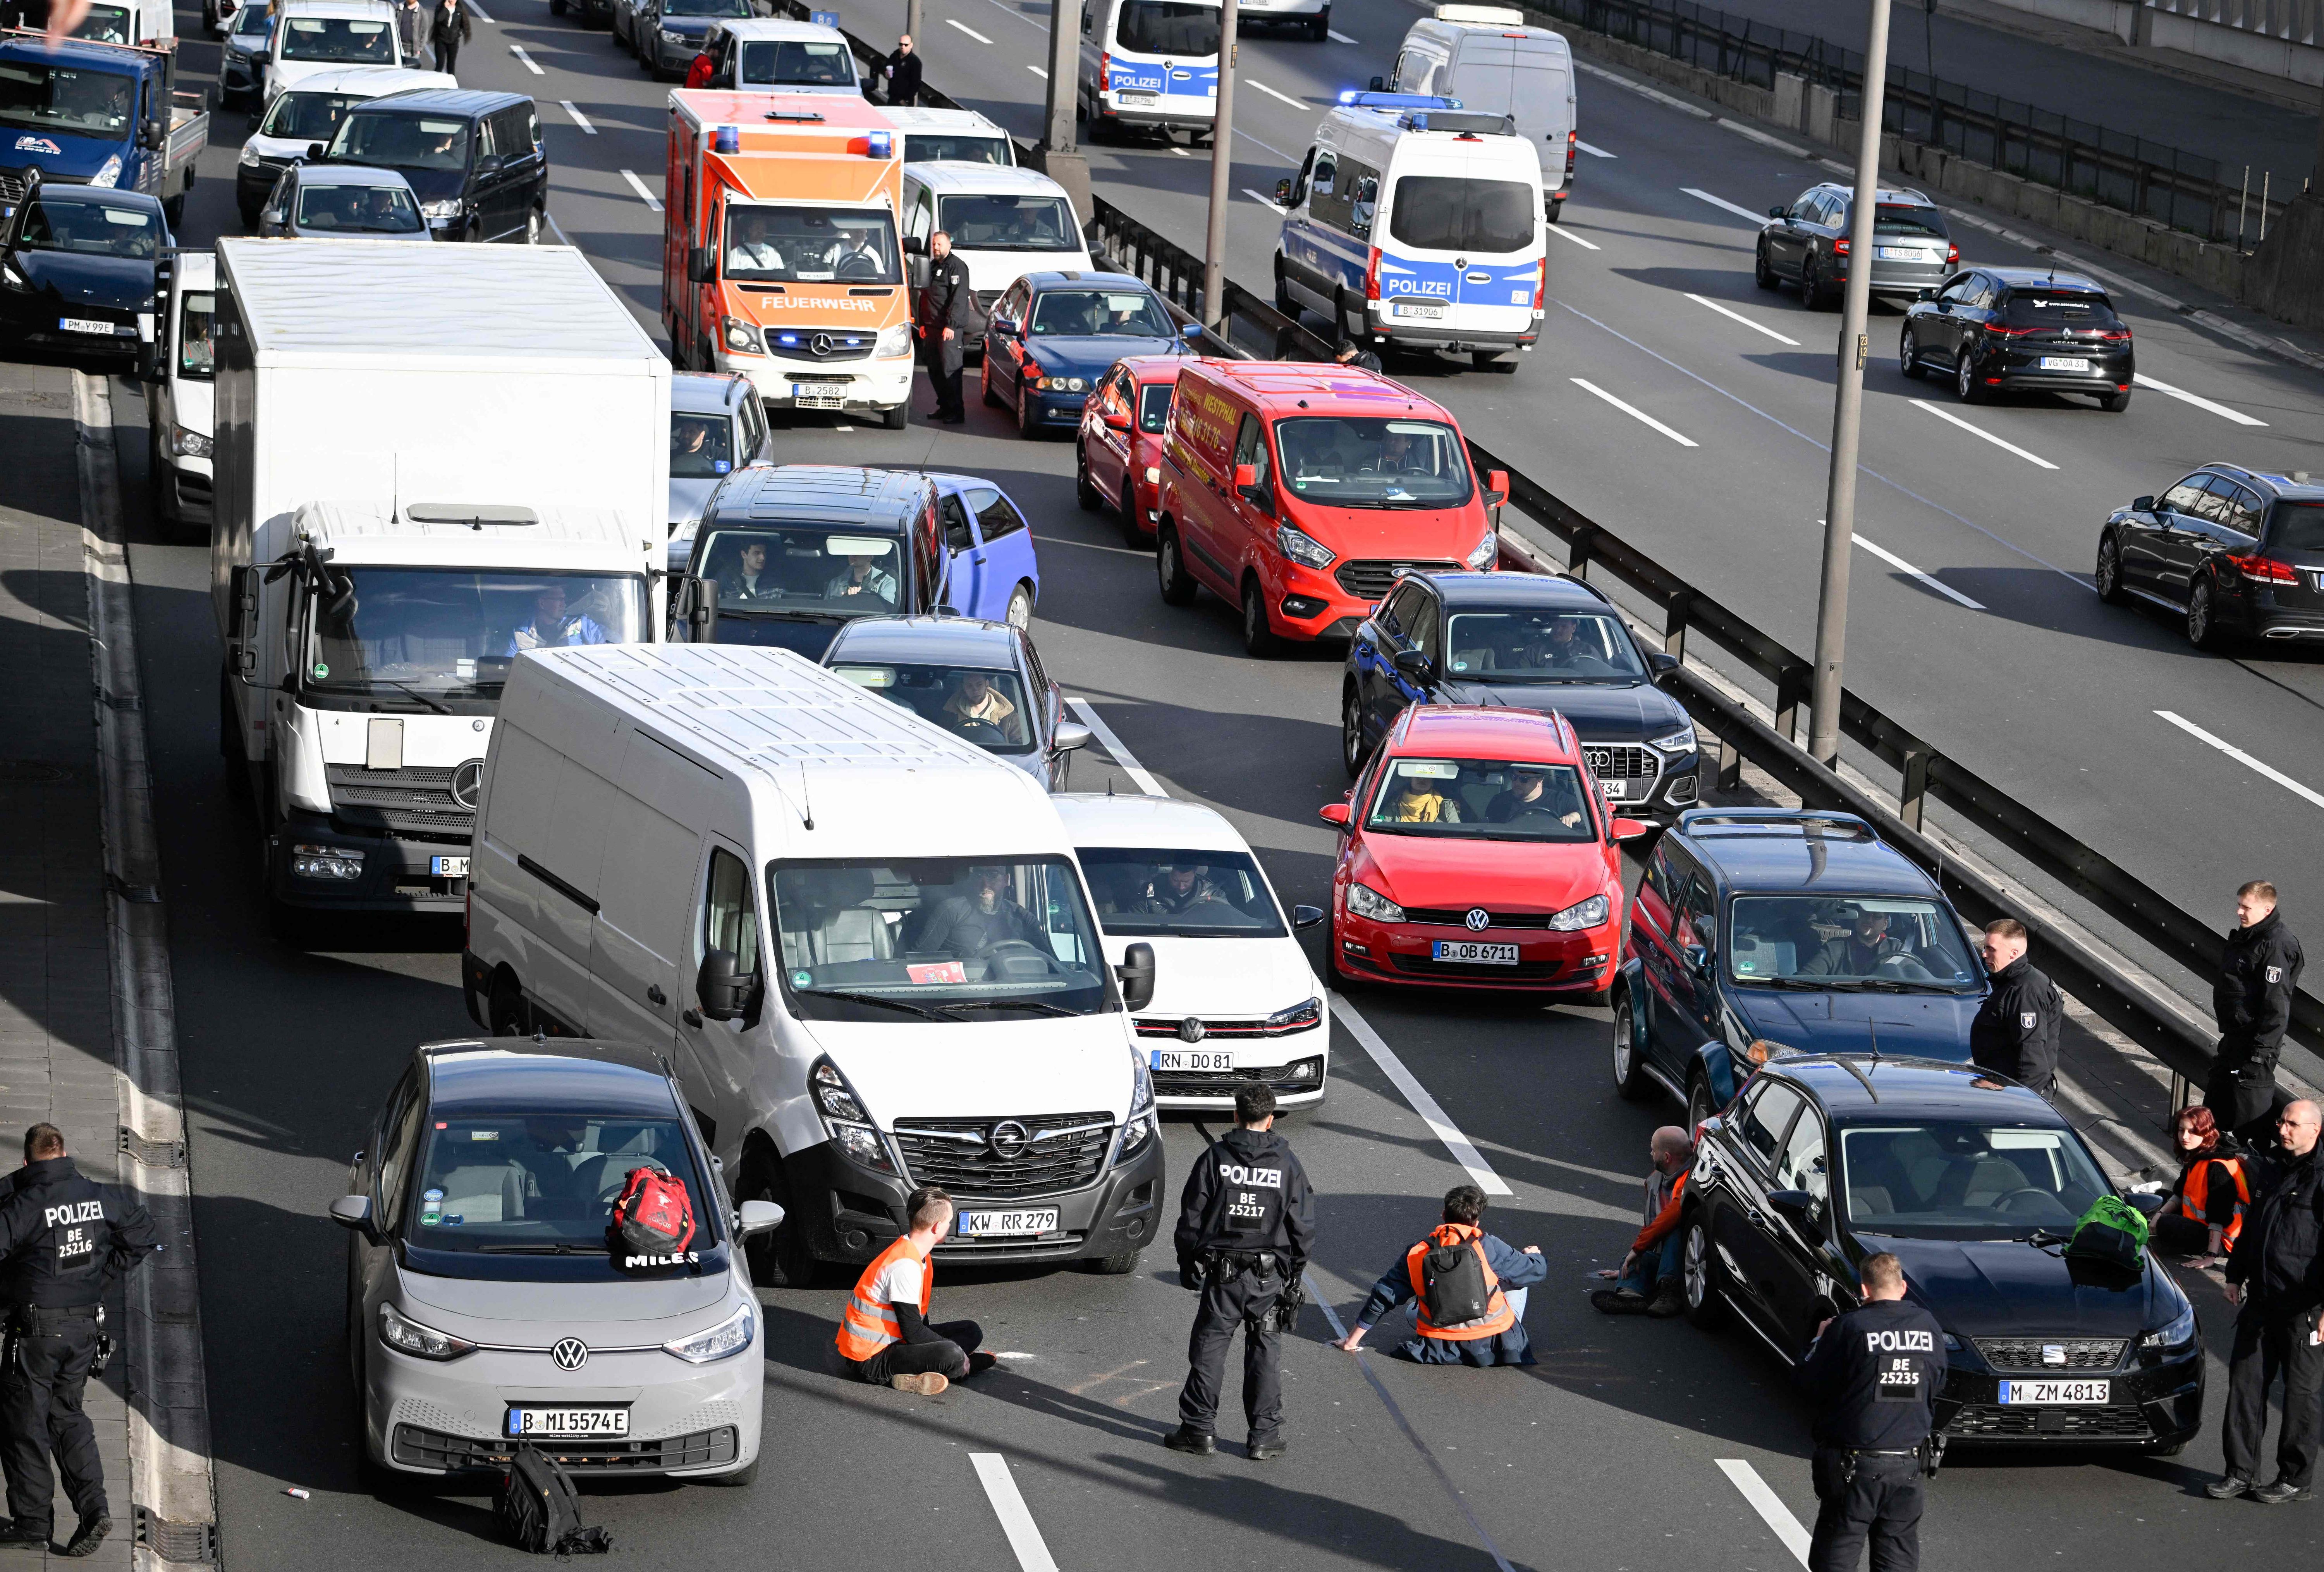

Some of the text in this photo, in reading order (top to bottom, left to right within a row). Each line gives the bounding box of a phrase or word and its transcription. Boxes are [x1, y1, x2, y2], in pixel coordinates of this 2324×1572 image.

[1114, 76, 1161, 88] POLIZEI
[1389, 279, 1451, 296] POLIZEI
[762, 297, 876, 312] FEUERWEHR
[1414, 307, 1438, 316] 31906
[69, 321, 80, 329] PM
[1861, 336, 1867, 345] 23
[1860, 347, 1867, 356] 12
[817, 387, 839, 395] 2582
[1203, 393, 1236, 426] WESTPHAL
[1201, 422, 1211, 443] 31
[1210, 427, 1220, 449] 76
[442, 859, 469, 871] B M
[1441, 944, 1515, 960] B OB 6711
[1162, 1054, 1231, 1069] RN DO 81
[1219, 1165, 1281, 1188] POLIZEI
[1240, 1193, 1256, 1204] BE
[45, 1201, 104, 1227] POLIZEI
[1229, 1204, 1265, 1217] 25217
[647, 1215, 672, 1229] adidas
[970, 1212, 1055, 1230] KW RR 279
[68, 1228, 83, 1242] BE
[59, 1240, 92, 1258] 25216
[626, 1252, 698, 1268] MILES
[1867, 1331, 1933, 1351] POLIZEI
[1893, 1359, 1910, 1371] BE
[1880, 1372, 1919, 1385] 25235
[2011, 1384, 2107, 1401] M ZM 4813
[524, 1414, 533, 1430] B
[546, 1414, 565, 1430] MI
